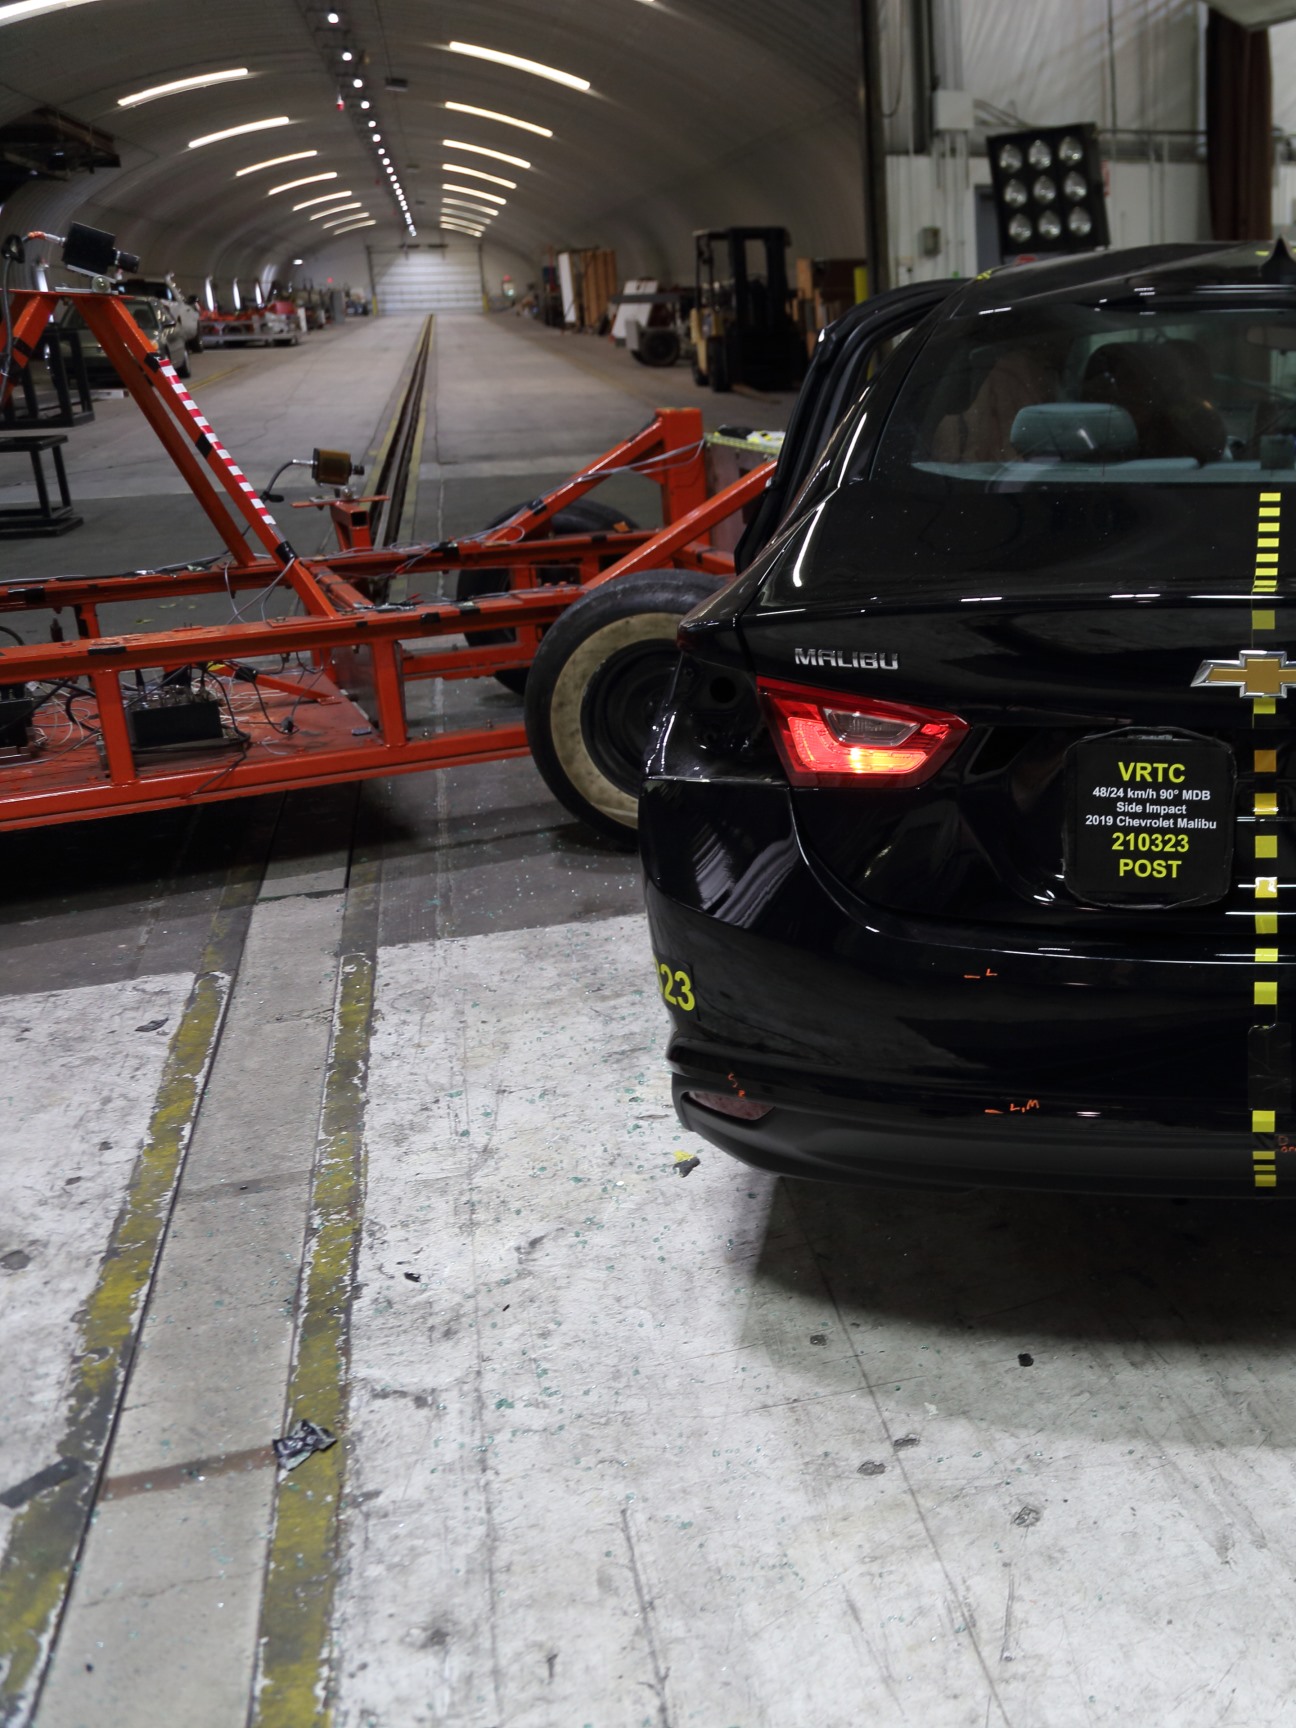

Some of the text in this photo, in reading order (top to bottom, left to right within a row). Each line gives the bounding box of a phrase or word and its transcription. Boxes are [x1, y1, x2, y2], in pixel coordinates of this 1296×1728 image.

[795, 648, 898, 670] MALIBU
[1118, 762, 1185, 783] VRTC
[1093, 787, 1210, 800] 48/24 km/h 90° MDB
[1117, 802, 1186, 815] Side Impact
[1086, 815, 1216, 829] 2019 Chevrolet Malibu
[1112, 833, 1189, 852] 210323
[1120, 859, 1181, 878] POST
[655, 955, 695, 1011] 23
